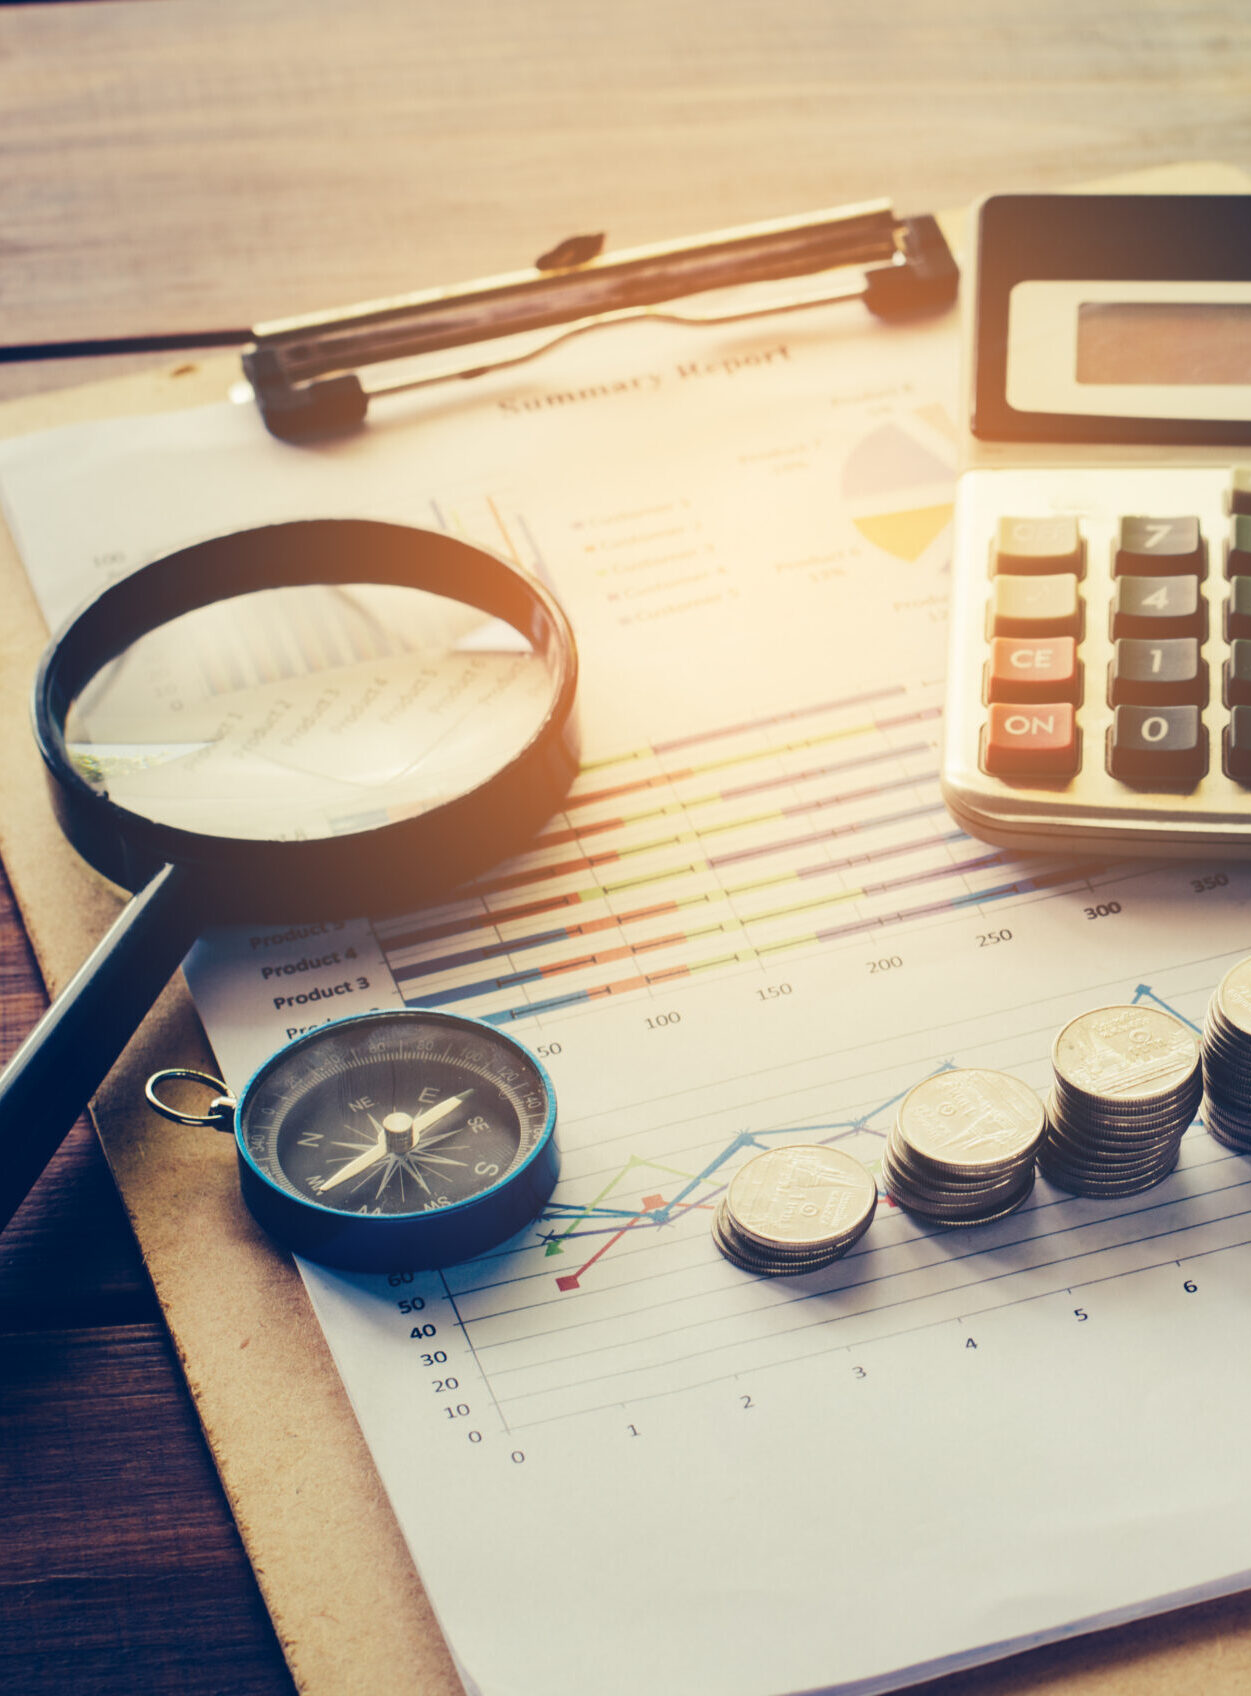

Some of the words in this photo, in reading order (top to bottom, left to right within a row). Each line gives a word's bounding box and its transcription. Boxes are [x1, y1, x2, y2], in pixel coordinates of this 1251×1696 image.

[497, 373, 663, 414] Summary
[676, 343, 792, 380] Report
[1144, 524, 1173, 548] 7
[1141, 586, 1170, 610] 4
[1010, 650, 1053, 668] CE
[1150, 650, 1164, 673] 1
[1005, 715, 1055, 736] ON
[1141, 717, 1169, 742] 0
[1190, 872, 1229, 893] 350
[1084, 901, 1122, 920] 300
[975, 928, 1013, 948] 250
[261, 951, 342, 980] Product
[345, 947, 359, 960] 4
[865, 956, 904, 974] 200
[273, 981, 354, 1011] Product
[356, 976, 370, 990] 3
[755, 982, 793, 1002] 150
[644, 1011, 681, 1030] 100
[536, 1042, 563, 1059] 50
[347, 1095, 375, 1113] NE
[418, 1087, 440, 1105] E
[467, 1115, 491, 1135] SE
[297, 1132, 325, 1148] N
[474, 1160, 499, 1177] S
[387, 1271, 415, 1288] 60
[1183, 1279, 1198, 1293] 6
[398, 1296, 426, 1315] 50
[1073, 1308, 1089, 1322] 5
[410, 1323, 437, 1340] 40
[965, 1337, 978, 1350] 4
[420, 1350, 448, 1367] 30
[852, 1366, 867, 1379] 3
[431, 1377, 459, 1393] 20
[443, 1403, 470, 1419] 10
[739, 1395, 755, 1409] 2
[468, 1431, 482, 1444] 0
[627, 1424, 641, 1437] 1
[511, 1451, 525, 1465] 0
